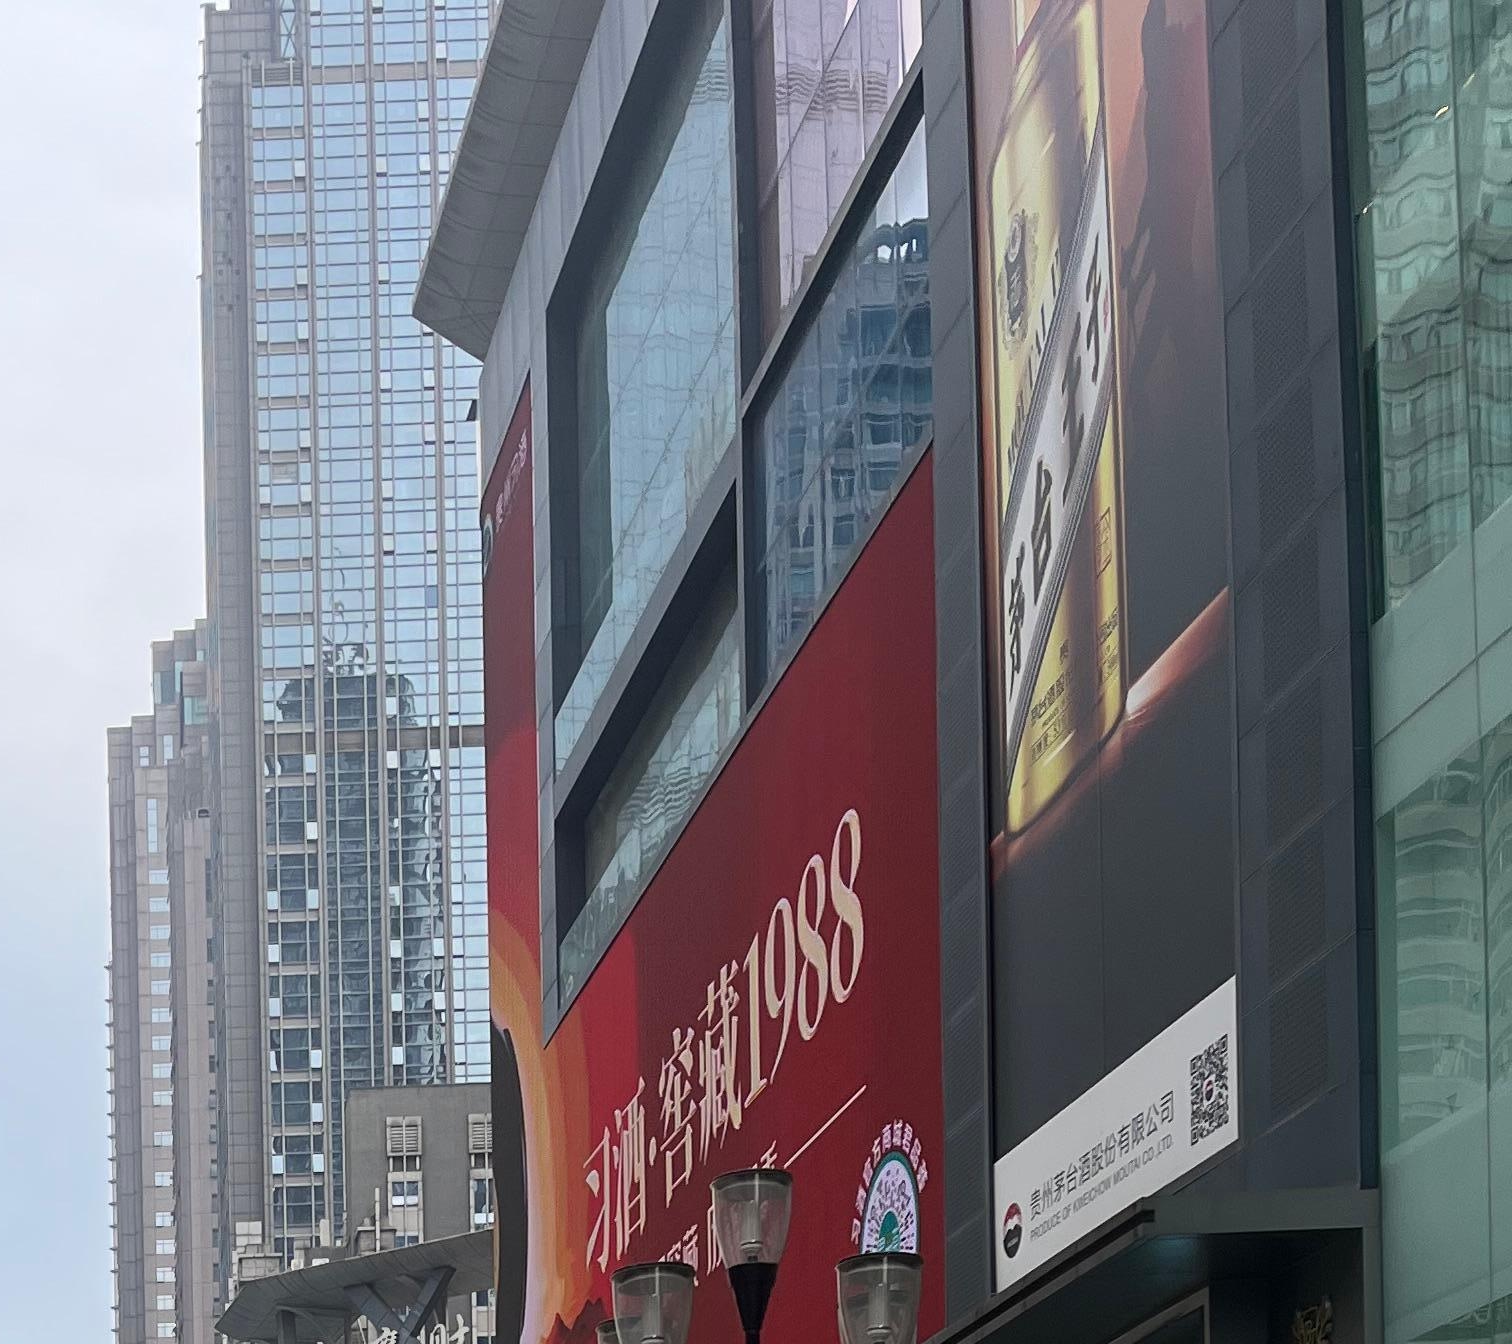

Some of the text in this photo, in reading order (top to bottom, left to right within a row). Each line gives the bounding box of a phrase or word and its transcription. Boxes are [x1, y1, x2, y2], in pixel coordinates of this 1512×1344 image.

[1030, 1090, 1175, 1222] 贵州茅台酒股份有限公司
[1030, 1210, 1062, 1242] PRODUCE
[1062, 1203, 1071, 1220] OF
